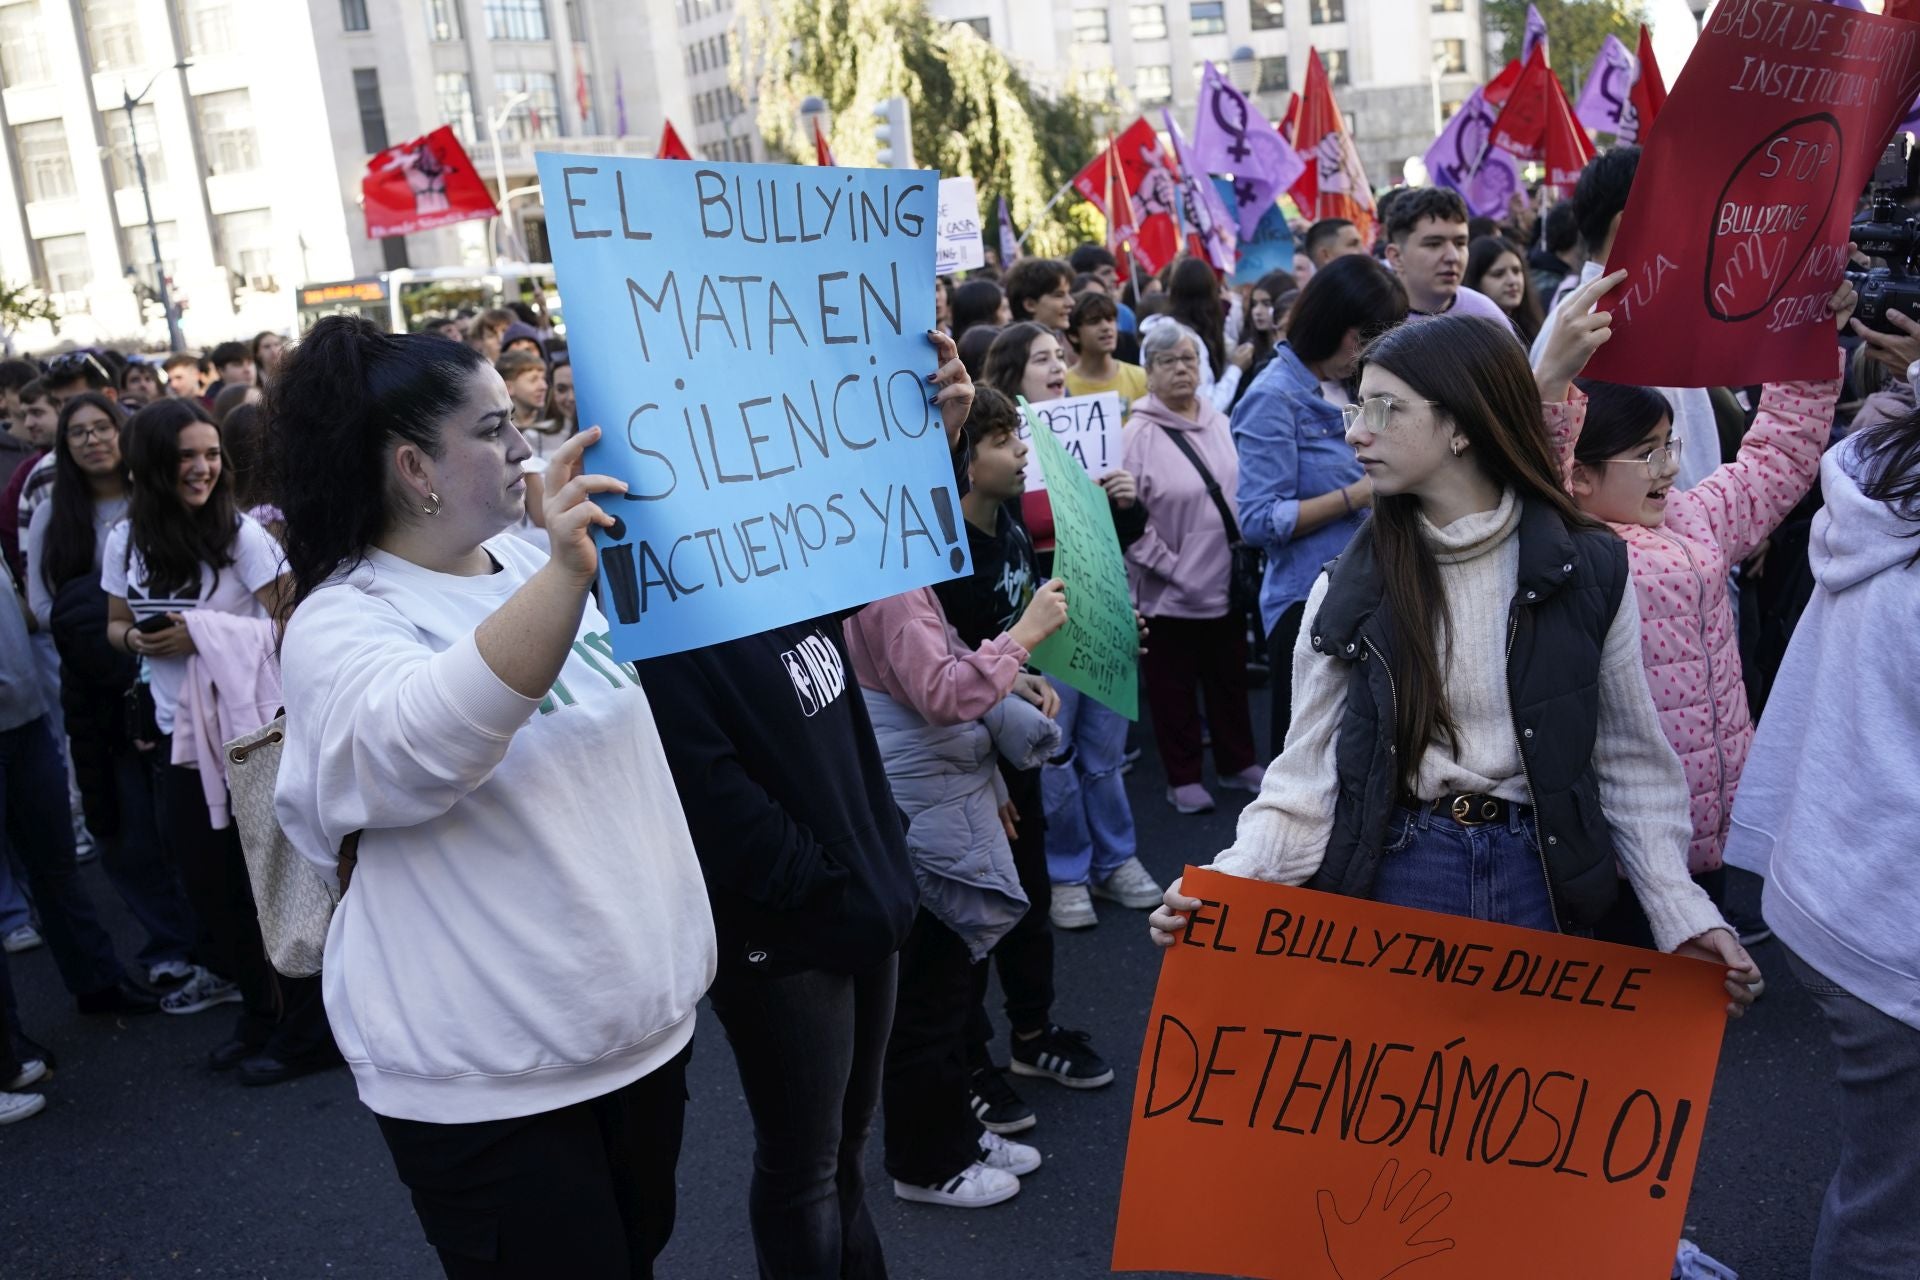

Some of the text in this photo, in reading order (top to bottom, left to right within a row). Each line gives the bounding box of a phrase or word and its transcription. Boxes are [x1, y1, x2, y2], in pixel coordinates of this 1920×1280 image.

[1792, 10, 1835, 52] DE
[1760, 137, 1833, 182] STOP
[563, 166, 653, 241] EL
[1717, 202, 1809, 235] BULLYING
[626, 261, 902, 363] MATA EN
[1611, 253, 1679, 330] TÚA
[859, 484, 966, 575] YA!
[1182, 899, 1651, 1011] EL BULLYING DUELE
[1143, 1015, 1692, 1199] DETENGÁMOSLO!
